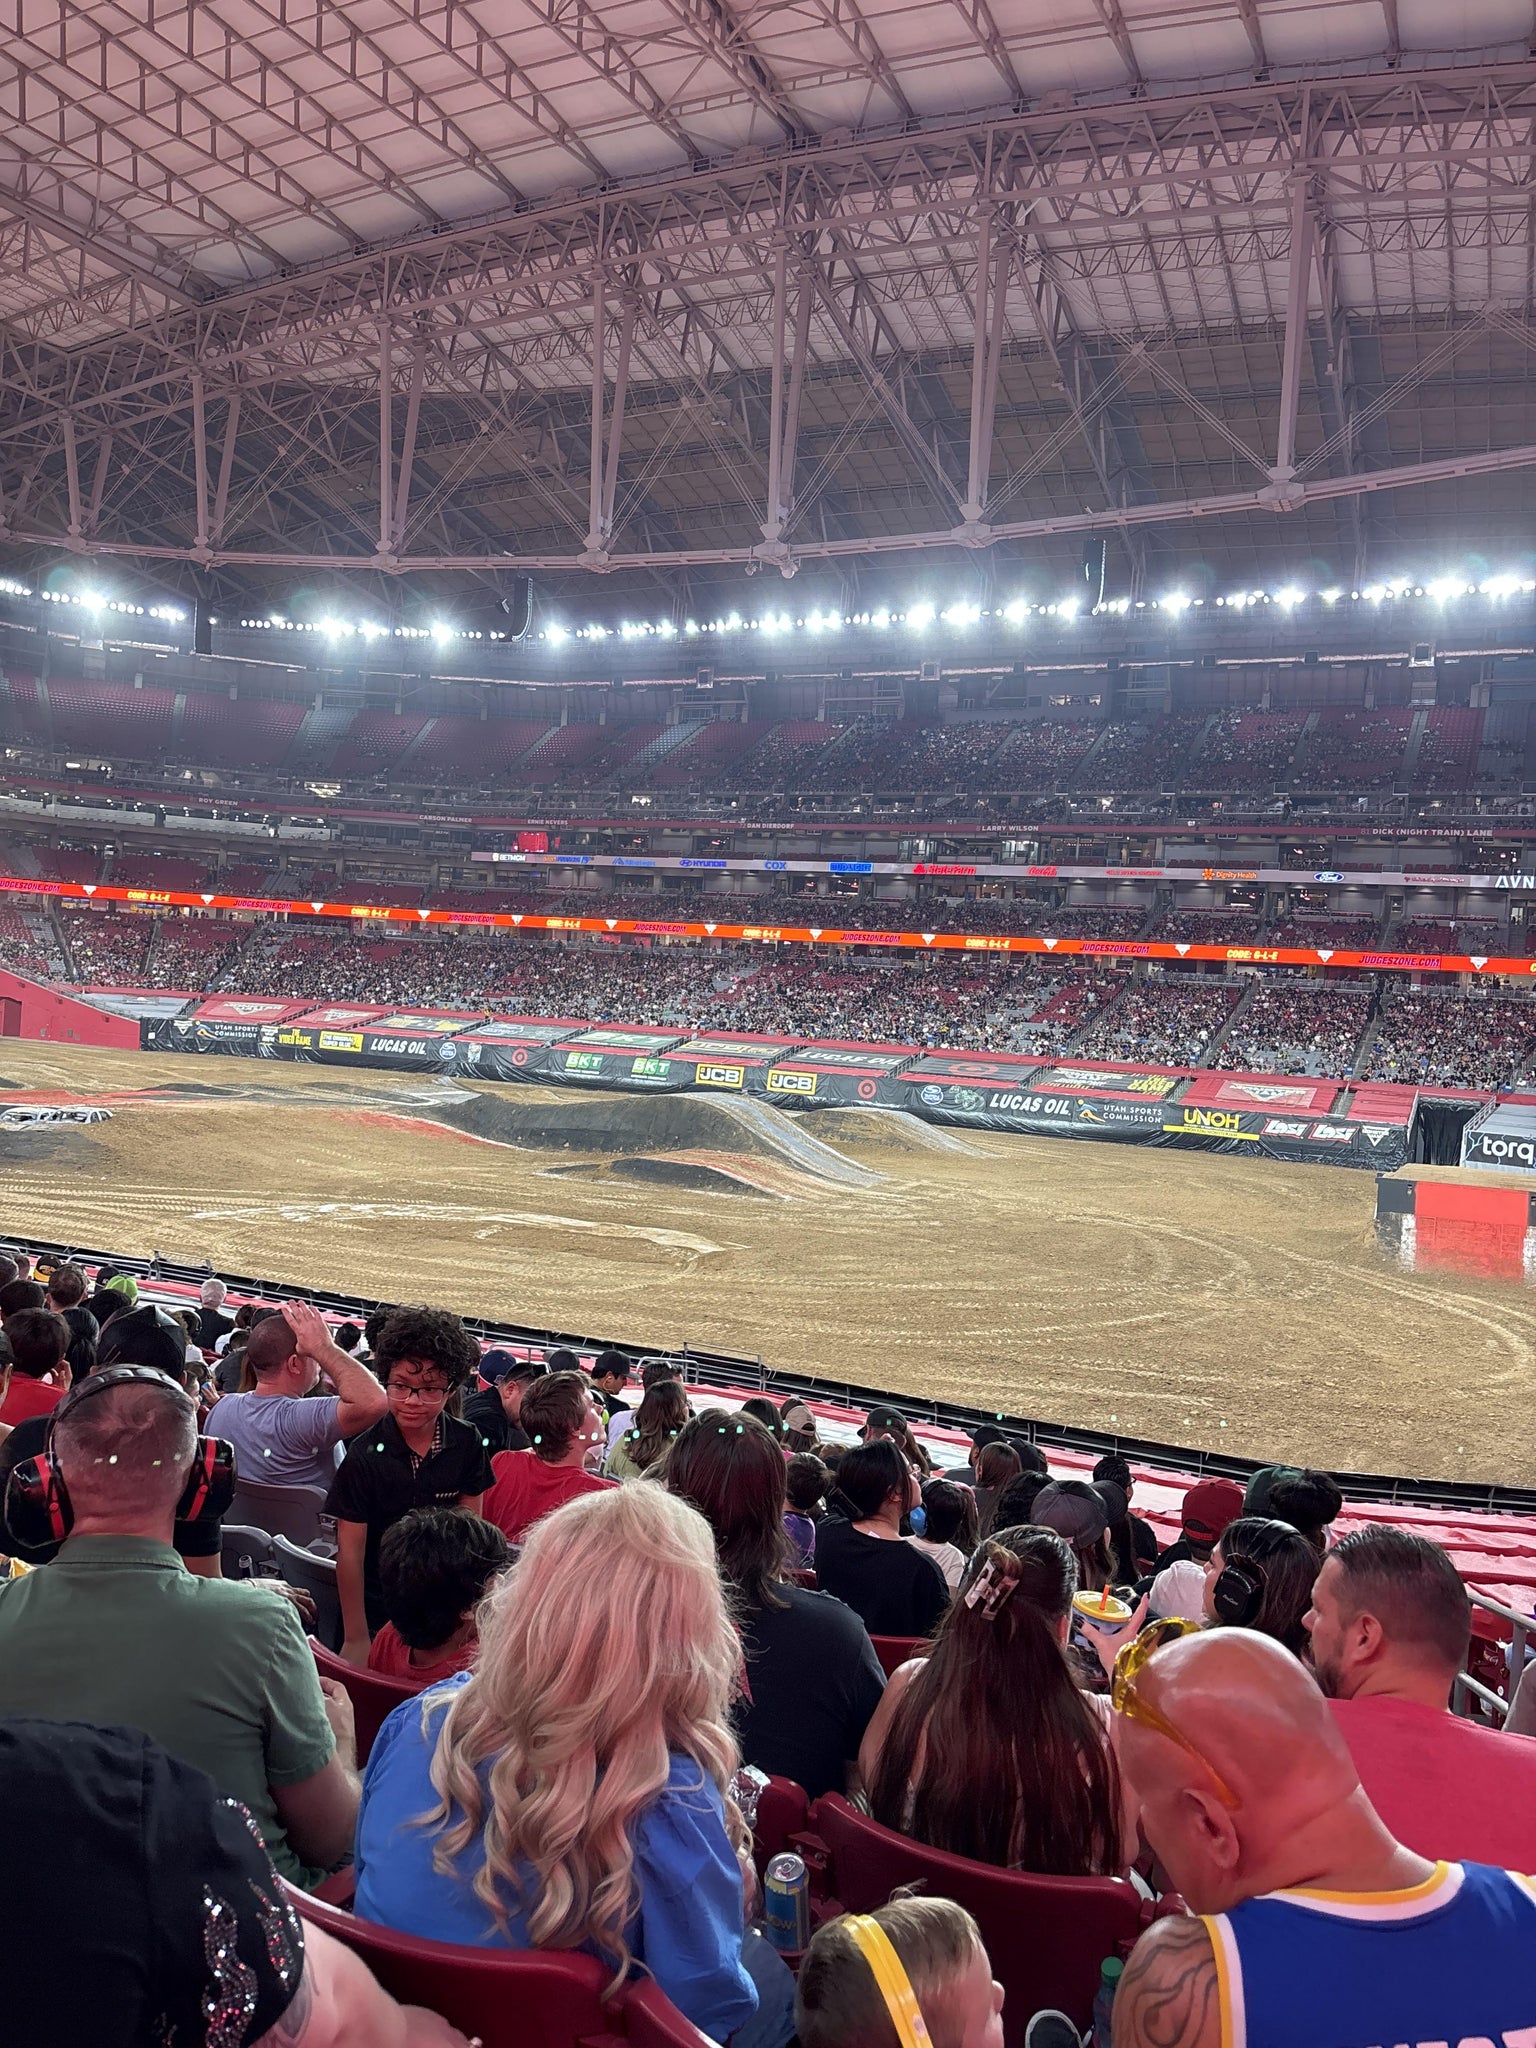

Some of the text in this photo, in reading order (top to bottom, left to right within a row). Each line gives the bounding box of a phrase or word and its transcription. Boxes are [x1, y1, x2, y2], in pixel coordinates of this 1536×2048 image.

[419, 814, 446, 822] CARSON
[1372, 828, 1394, 836] DICK
[1396, 828, 1430, 837] (NIGHT
[1431, 829, 1465, 837] TRAIN)
[1466, 829, 1493, 837] LANE
[765, 861, 787, 870] COX
[1216, 871, 1237, 880] Dignity
[0, 879, 60, 892] UDGESZONE.COM
[233, 900, 292, 910] JUDGESZONE.COM
[447, 915, 495, 923] JUDGESZONE.COM
[633, 923, 686, 932] JUDGESZONE.COM
[841, 933, 901, 943] JUDGESZONE.COM
[1080, 943, 1150, 954] JUDGESZONE.COM
[1226, 949, 1279, 960] CODE: G-L-E
[1359, 956, 1440, 967] JUDGESZONE.COM
[234, 1025, 258, 1033] SPORTS
[279, 1034, 295, 1044] VIDEO
[296, 1035, 312, 1046] GAME
[370, 1038, 407, 1053] LUCAS
[566, 1053, 603, 1069] BKT
[797, 1051, 867, 1063] LUCAS
[632, 1058, 670, 1074] BKT
[699, 1067, 740, 1083] JCB
[771, 1074, 813, 1090] JCB
[989, 1093, 1042, 1112] LUCAS
[1104, 1105, 1162, 1116] UTAH SPORTS
[1103, 1112, 1162, 1123] COMMISSION
[1184, 1107, 1241, 1129] UNOH
[1482, 1135, 1535, 1165] torq
